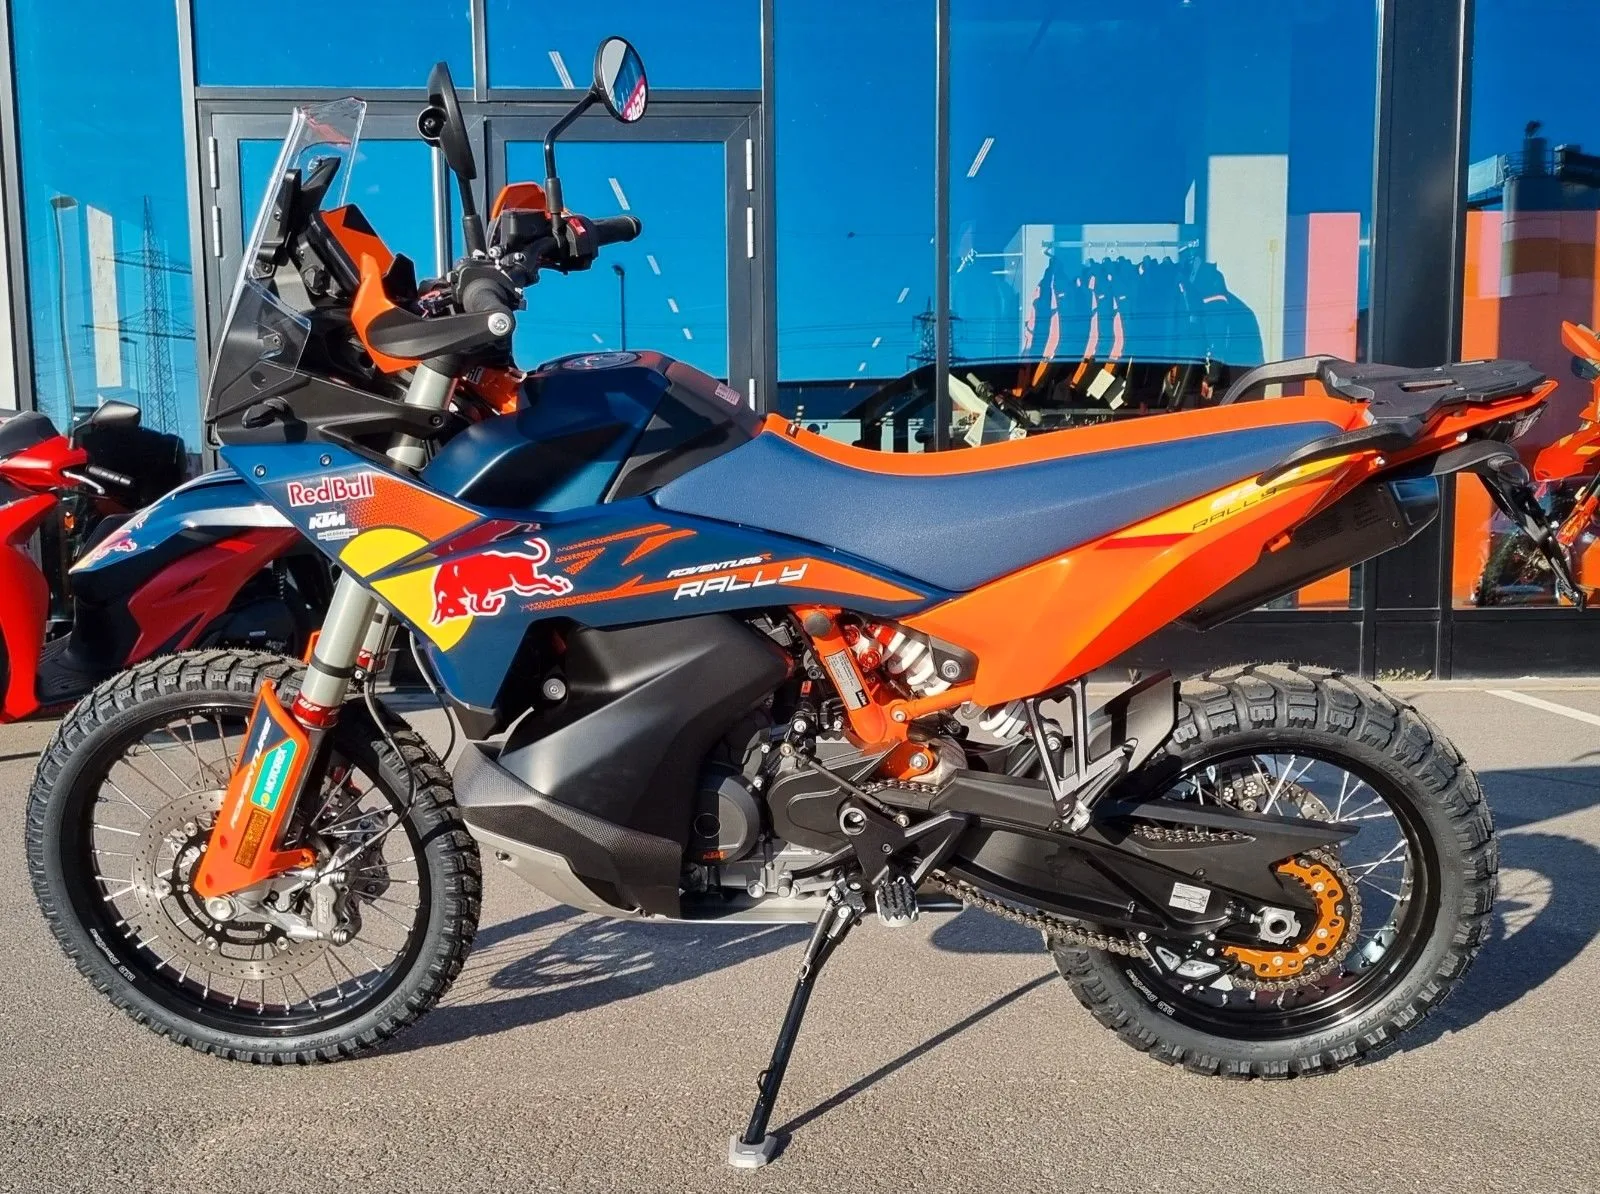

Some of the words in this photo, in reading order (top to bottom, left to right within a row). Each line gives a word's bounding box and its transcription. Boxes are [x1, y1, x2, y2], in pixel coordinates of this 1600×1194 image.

[287, 481, 332, 507] Red
[330, 472, 374, 501] Bull
[309, 512, 346, 530] KTM
[1193, 487, 1277, 531] RALLY
[673, 563, 808, 600] RALLY
[264, 746, 288, 794] MOTOREX
